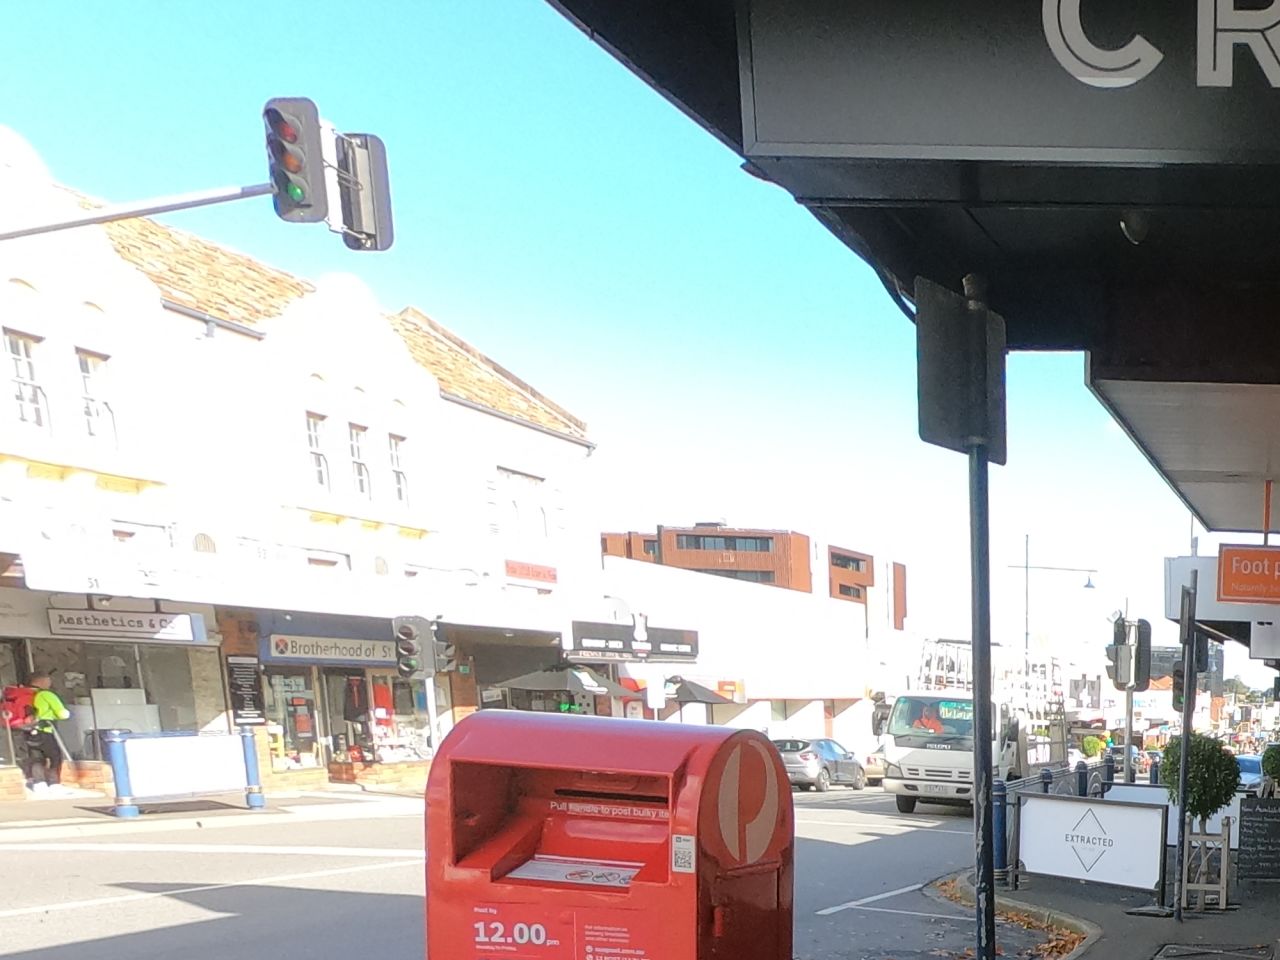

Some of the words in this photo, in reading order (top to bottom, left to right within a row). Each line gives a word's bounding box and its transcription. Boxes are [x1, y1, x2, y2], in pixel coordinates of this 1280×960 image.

[1231, 556, 1269, 576] Foot
[58, 614, 144, 629] Aesthetics
[148, 618, 156, 629] &
[290, 640, 362, 657] Brotherhood
[364, 642, 376, 657] of
[550, 801, 567, 810] Pull
[601, 805, 610, 814] to
[611, 807, 631, 816] post
[633, 807, 657, 818] bulky
[658, 810, 669, 818] ite
[1065, 833, 1114, 848] EXTRACTED
